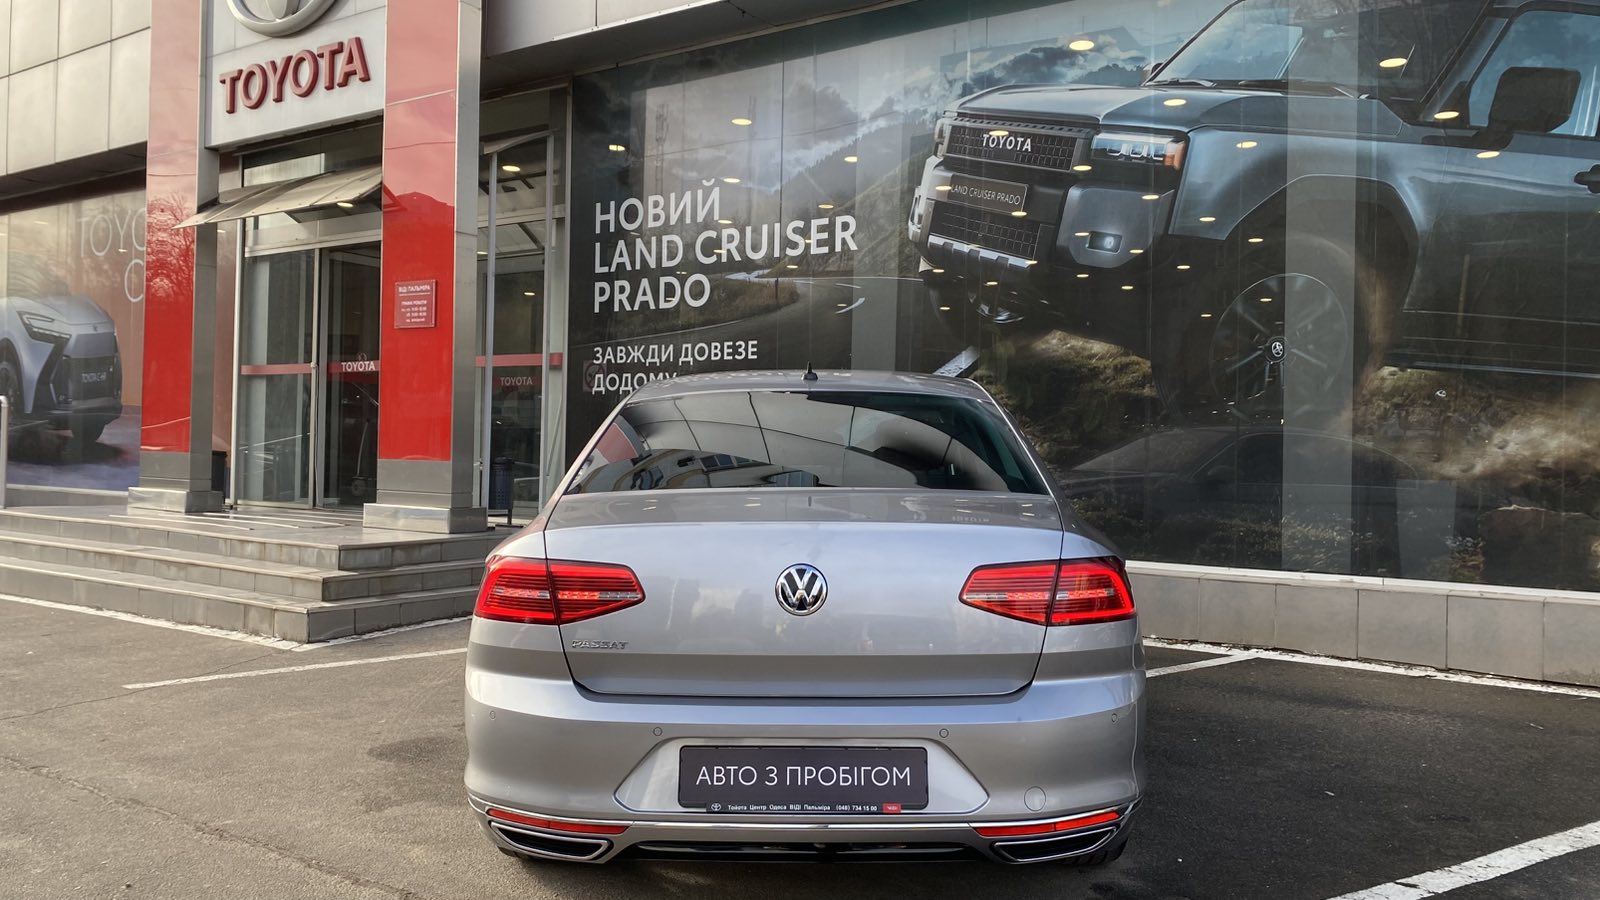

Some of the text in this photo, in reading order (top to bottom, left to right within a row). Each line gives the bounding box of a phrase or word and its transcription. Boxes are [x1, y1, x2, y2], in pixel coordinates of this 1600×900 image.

[219, 36, 371, 114] TOYOTA
[982, 134, 1031, 152] TOYOTA
[951, 184, 1021, 205] LAND CRUISER PRADO
[595, 178, 720, 234] НОВИЙ
[594, 215, 858, 273] LAND CRUISER
[593, 273, 711, 313] PRADO
[592, 340, 758, 367] ЗАВЖДИ ДОВЕЗЕ
[341, 361, 376, 372] TOYOTA
[500, 376, 533, 386] TOYOTA
[571, 640, 629, 650] PASSAT
[696, 766, 757, 786] АВТО
[786, 766, 911, 787] ПРОБІГОМ
[852, 804, 862, 812] 734
